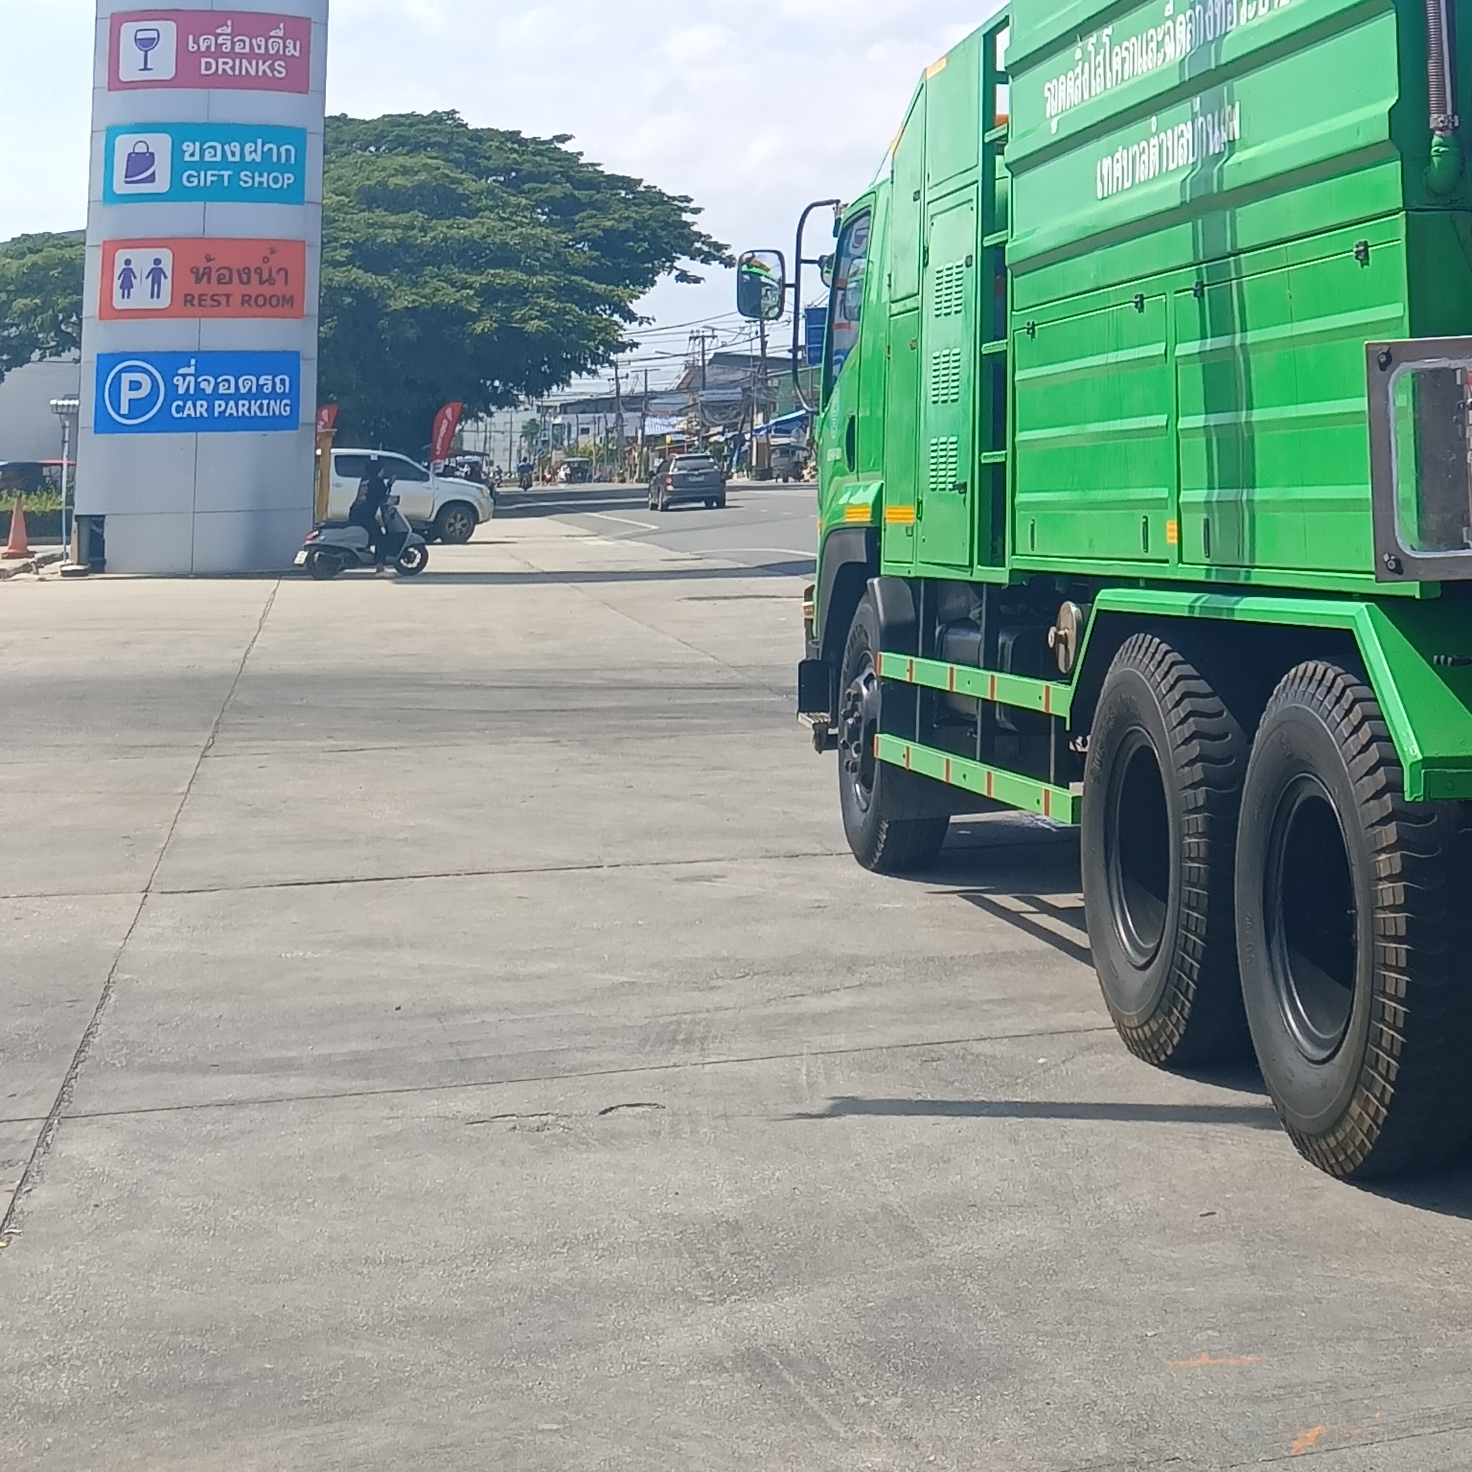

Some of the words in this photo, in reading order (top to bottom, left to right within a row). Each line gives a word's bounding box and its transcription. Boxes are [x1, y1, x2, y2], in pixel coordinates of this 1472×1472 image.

[187, 19, 301, 58] เครื่องดื่ม
[199, 57, 287, 78] DRINKS
[181, 138, 296, 165] ของฝาก
[181, 170, 233, 188] GIFT
[238, 170, 295, 189] SHOP
[189, 247, 289, 286] ห้องน้ำ
[183, 293, 233, 308] REST
[240, 293, 295, 309] ROOM
[172, 358, 291, 395] ที่จอดรถ
[119, 372, 152, 415] P
[170, 400, 208, 418] CAR
[213, 399, 291, 417] PARKING
